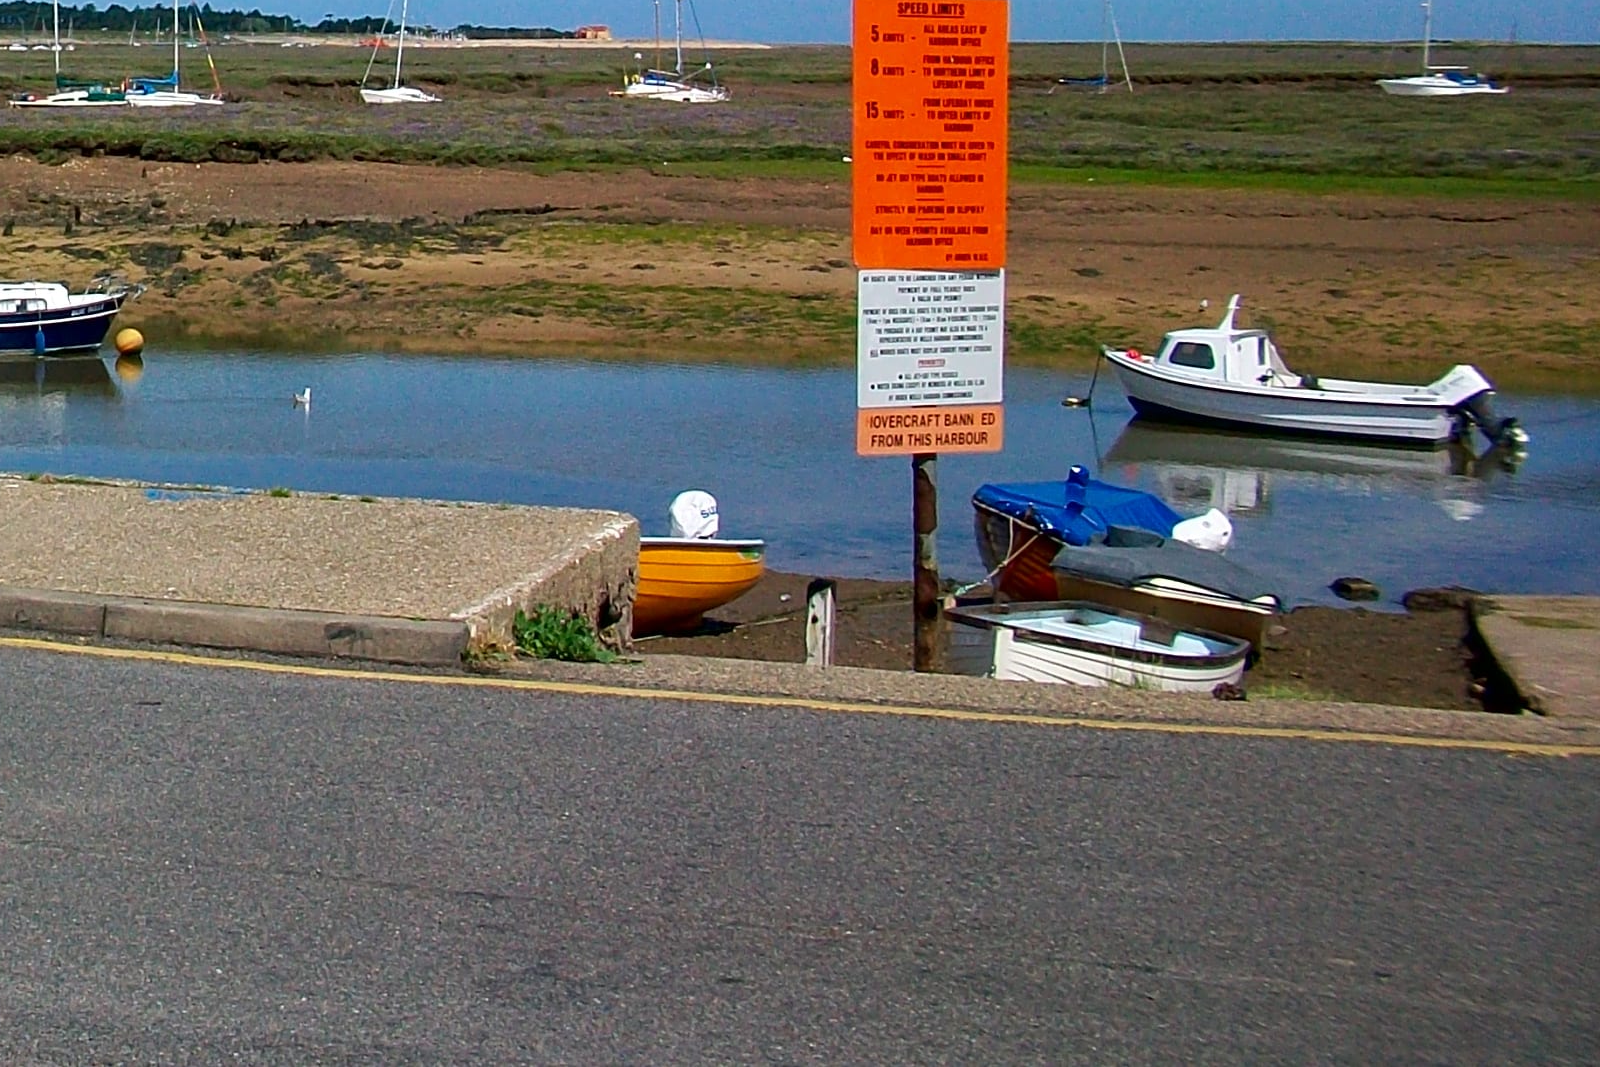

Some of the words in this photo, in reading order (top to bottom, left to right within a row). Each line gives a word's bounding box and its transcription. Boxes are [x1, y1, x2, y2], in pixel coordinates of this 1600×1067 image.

[897, 2, 929, 14] SPEED
[932, 3, 965, 16] LIMITS
[871, 25, 880, 43] 5
[871, 58, 879, 76] 8
[865, 101, 879, 119] 15
[871, 434, 904, 447] FROM
[908, 433, 932, 446] THIS
[935, 431, 988, 446] HARBOUR
